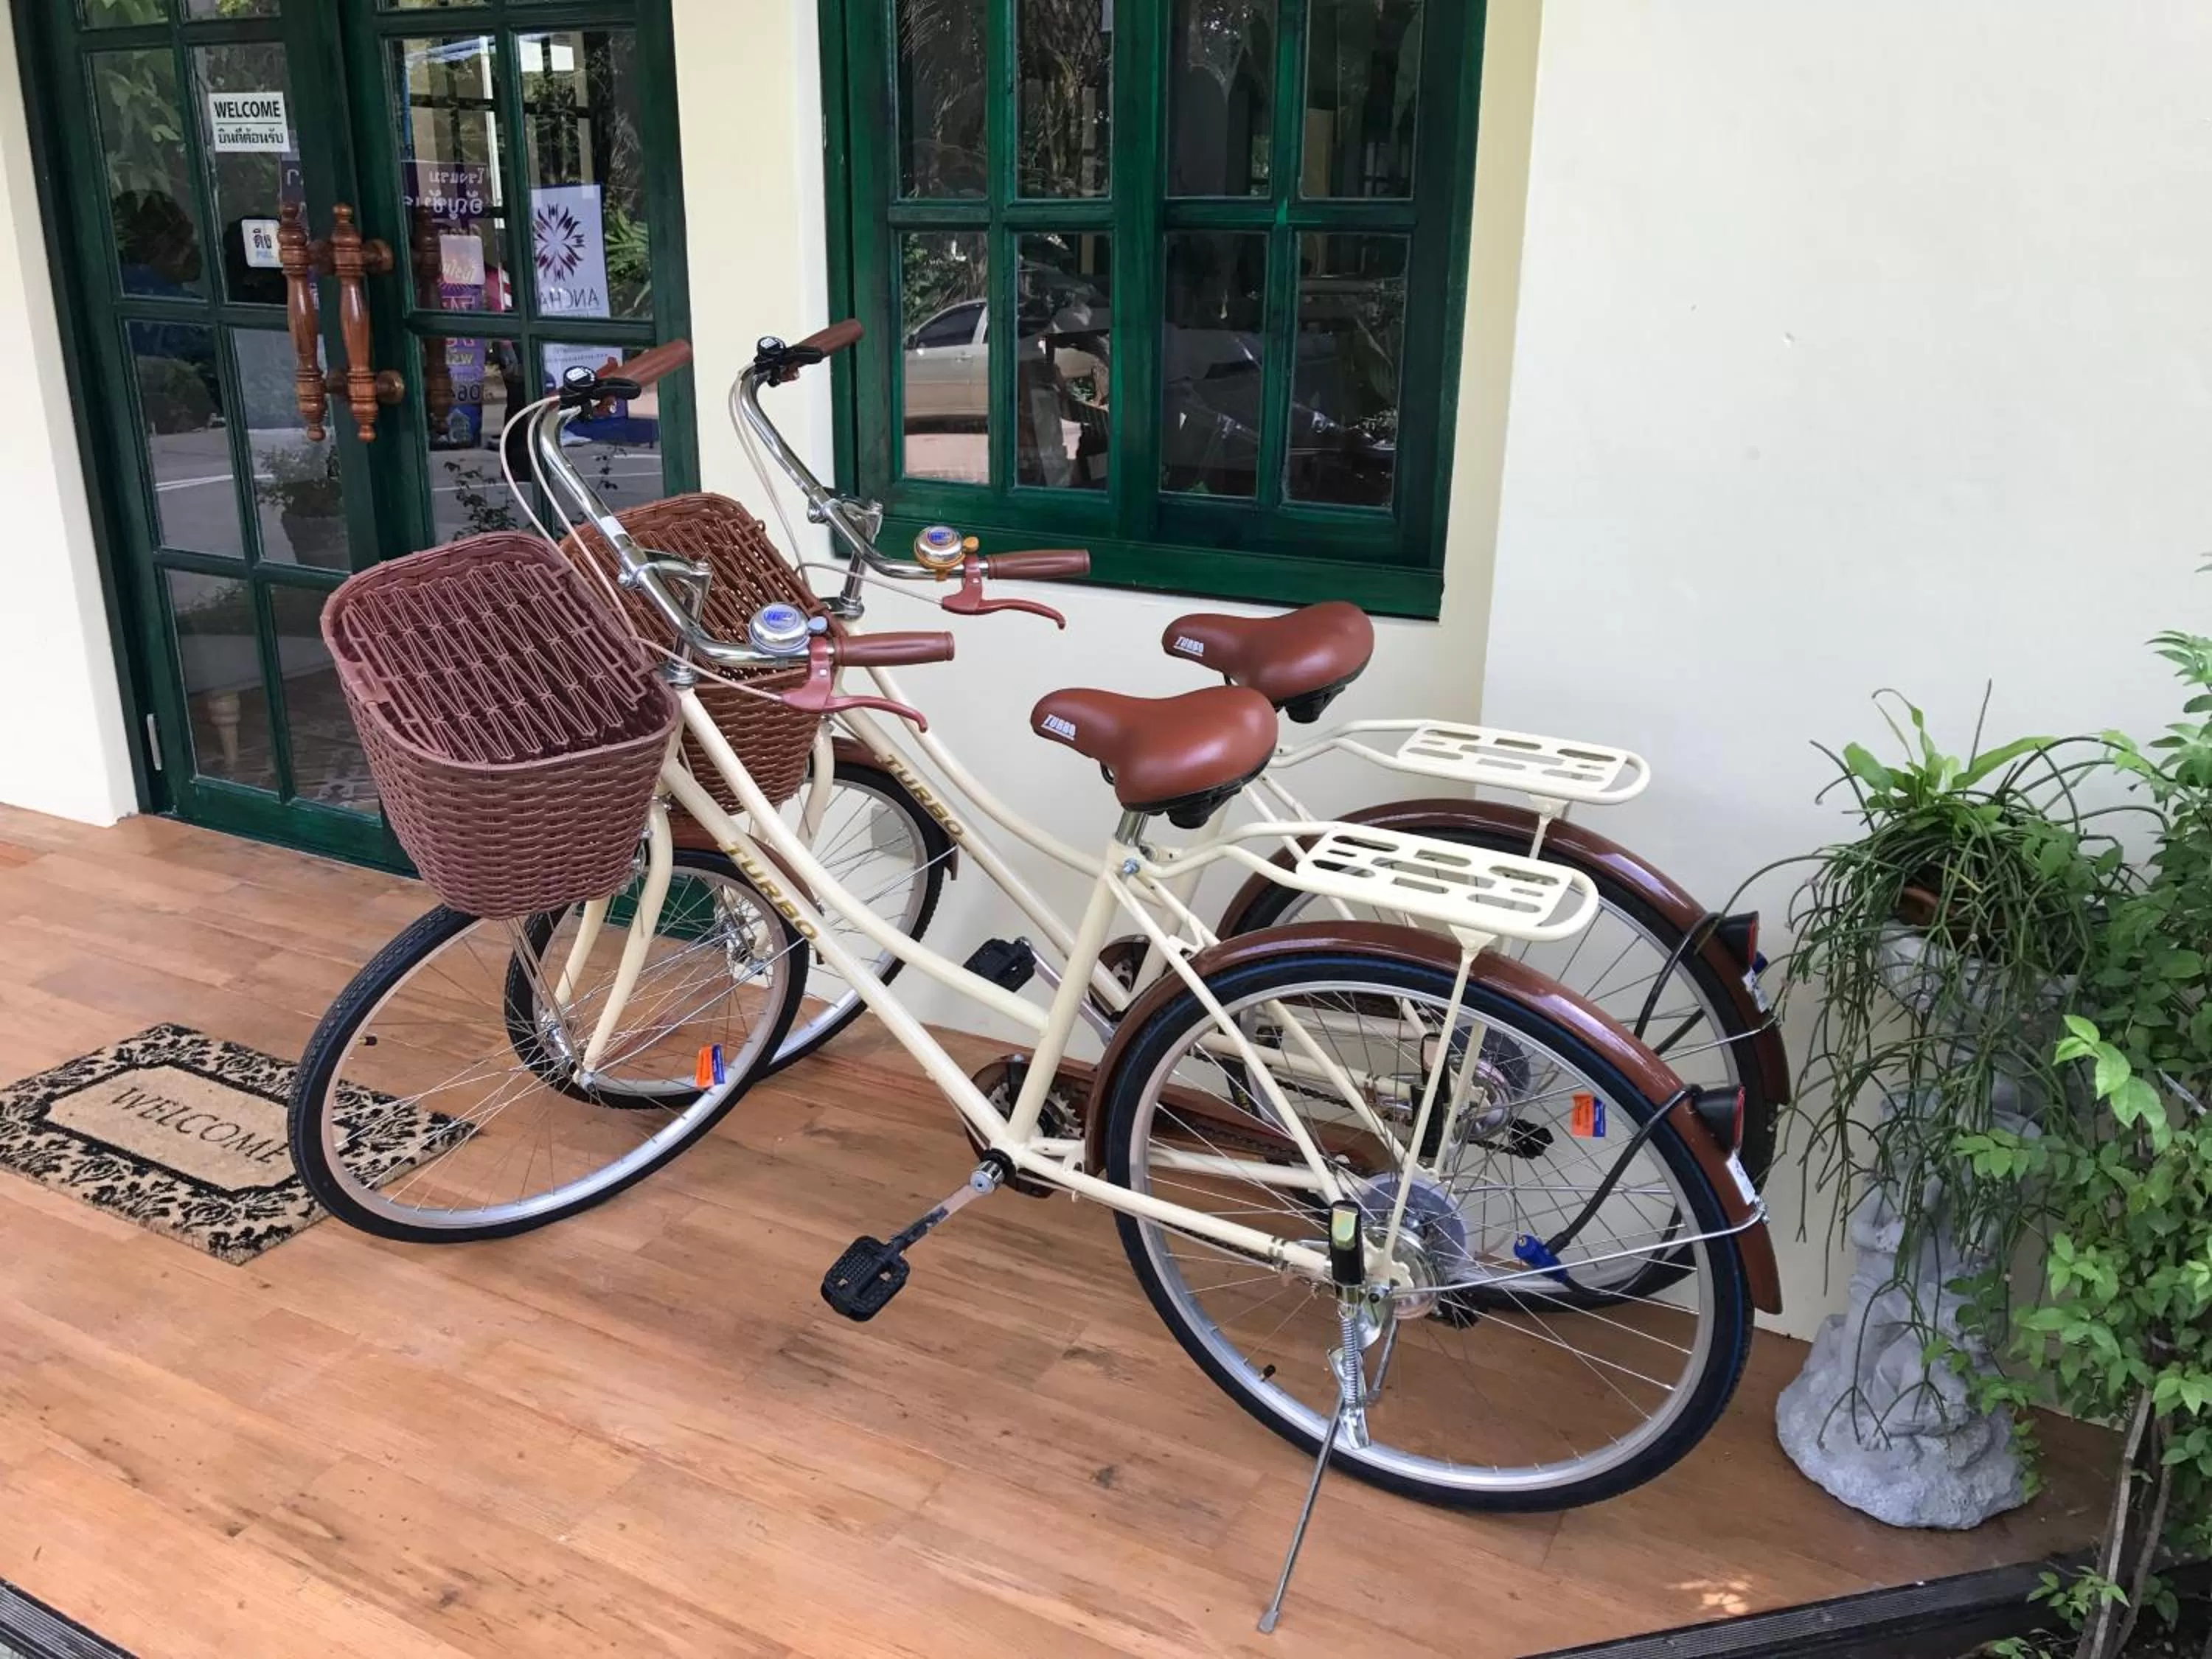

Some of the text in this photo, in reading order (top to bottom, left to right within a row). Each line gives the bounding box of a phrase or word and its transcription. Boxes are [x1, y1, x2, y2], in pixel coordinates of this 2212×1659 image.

[214, 100, 281, 118] WELCOME
[886, 754, 964, 837] TURBO
[726, 846, 818, 940] TURBO
